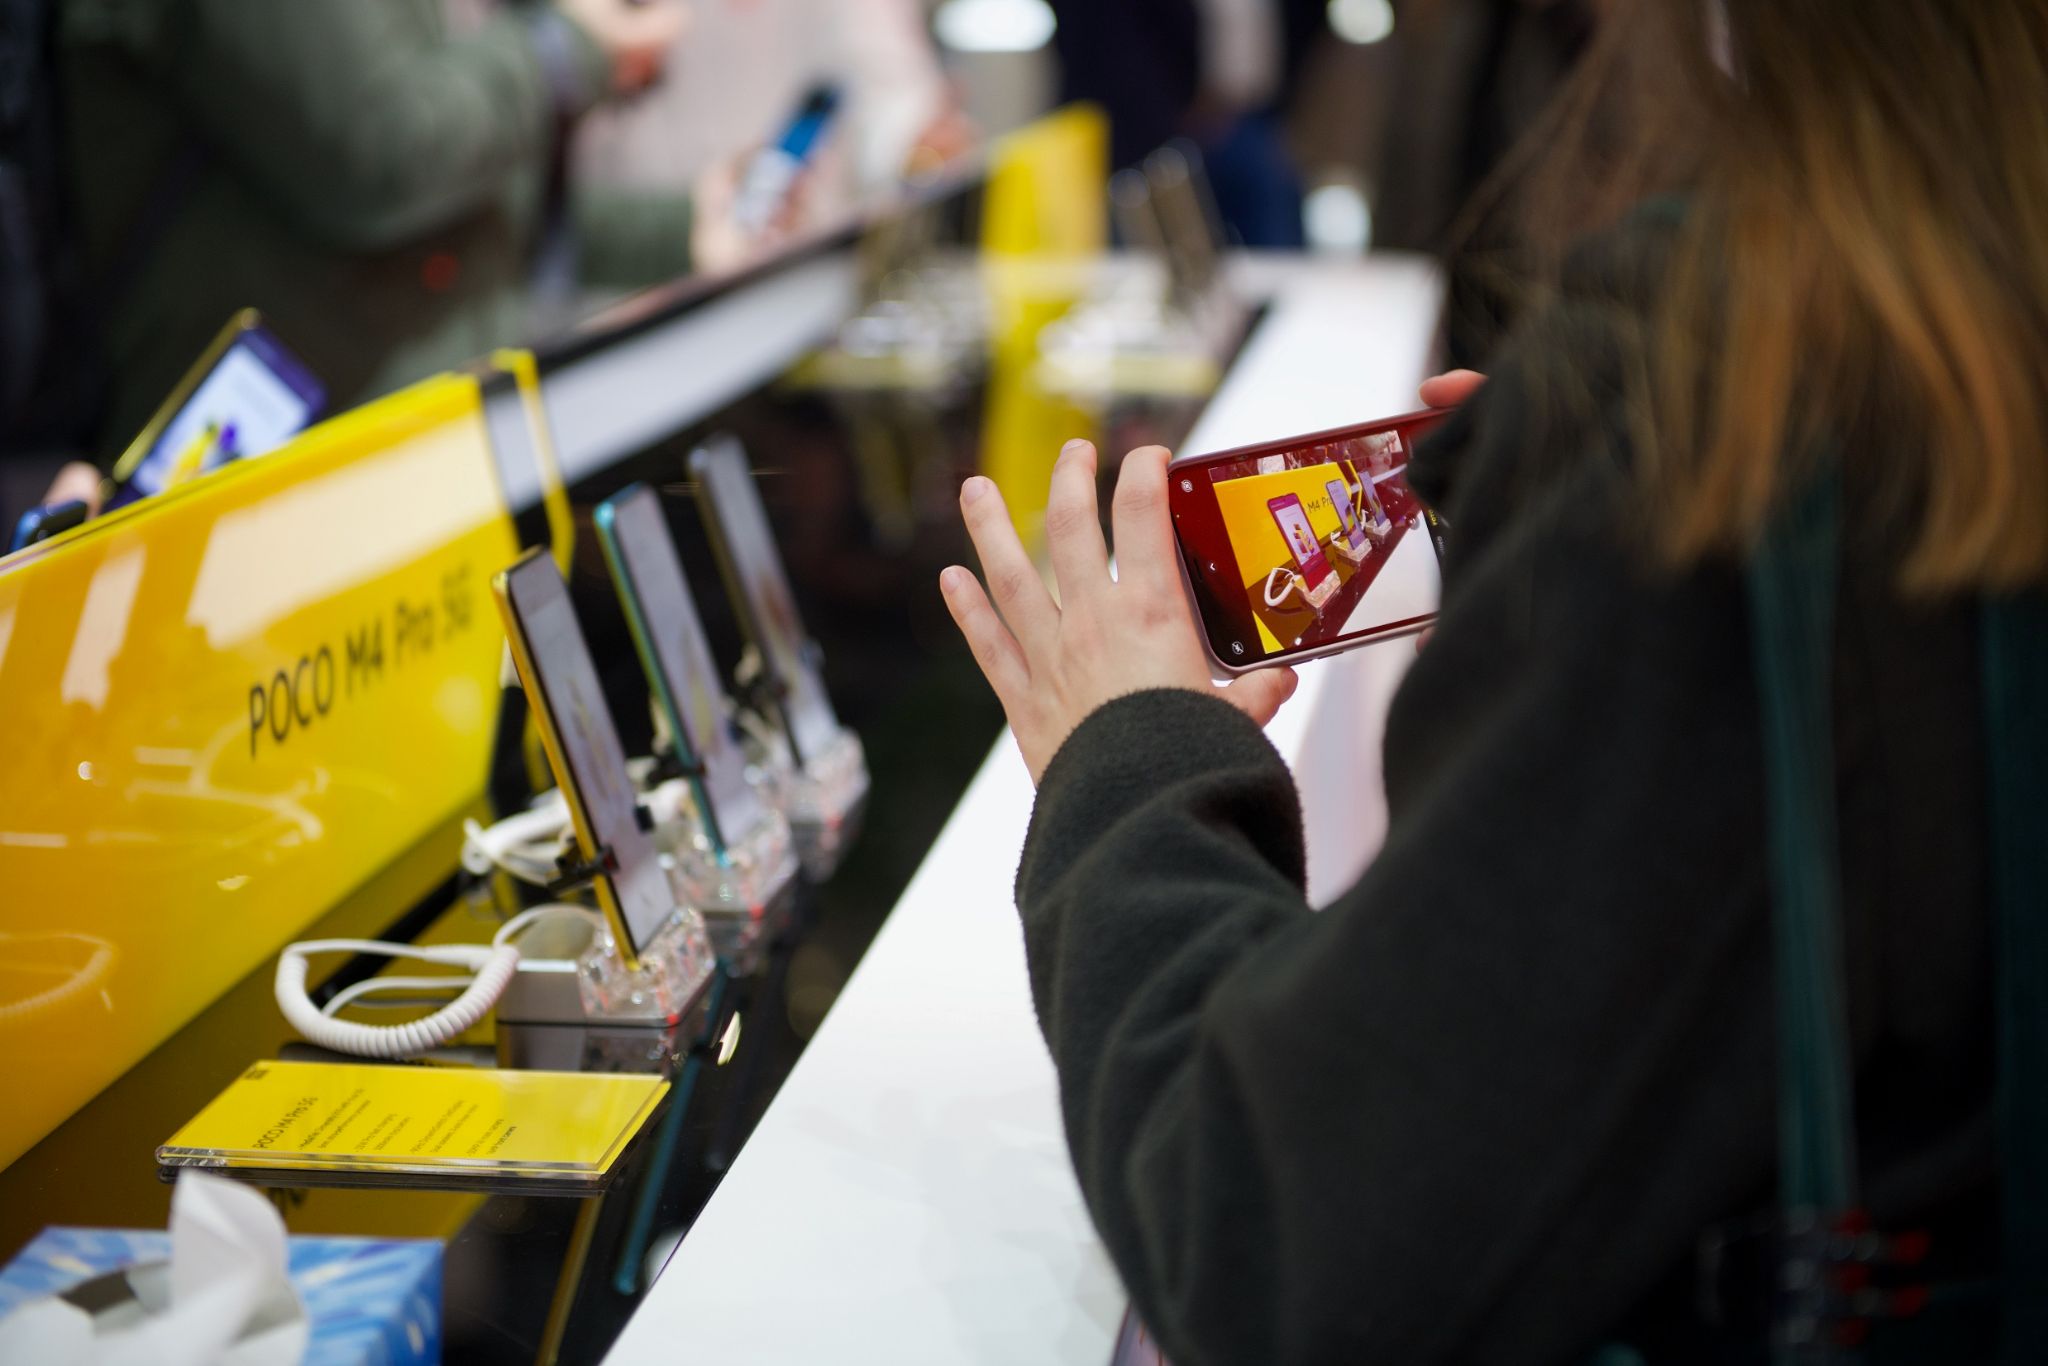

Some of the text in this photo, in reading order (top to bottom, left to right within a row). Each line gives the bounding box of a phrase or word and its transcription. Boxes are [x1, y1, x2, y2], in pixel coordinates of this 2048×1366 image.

[250, 643, 335, 761] POCO
[345, 612, 385, 703] M4
[394, 598, 434, 668] Pro
[251, 1128, 285, 1149] POCO
